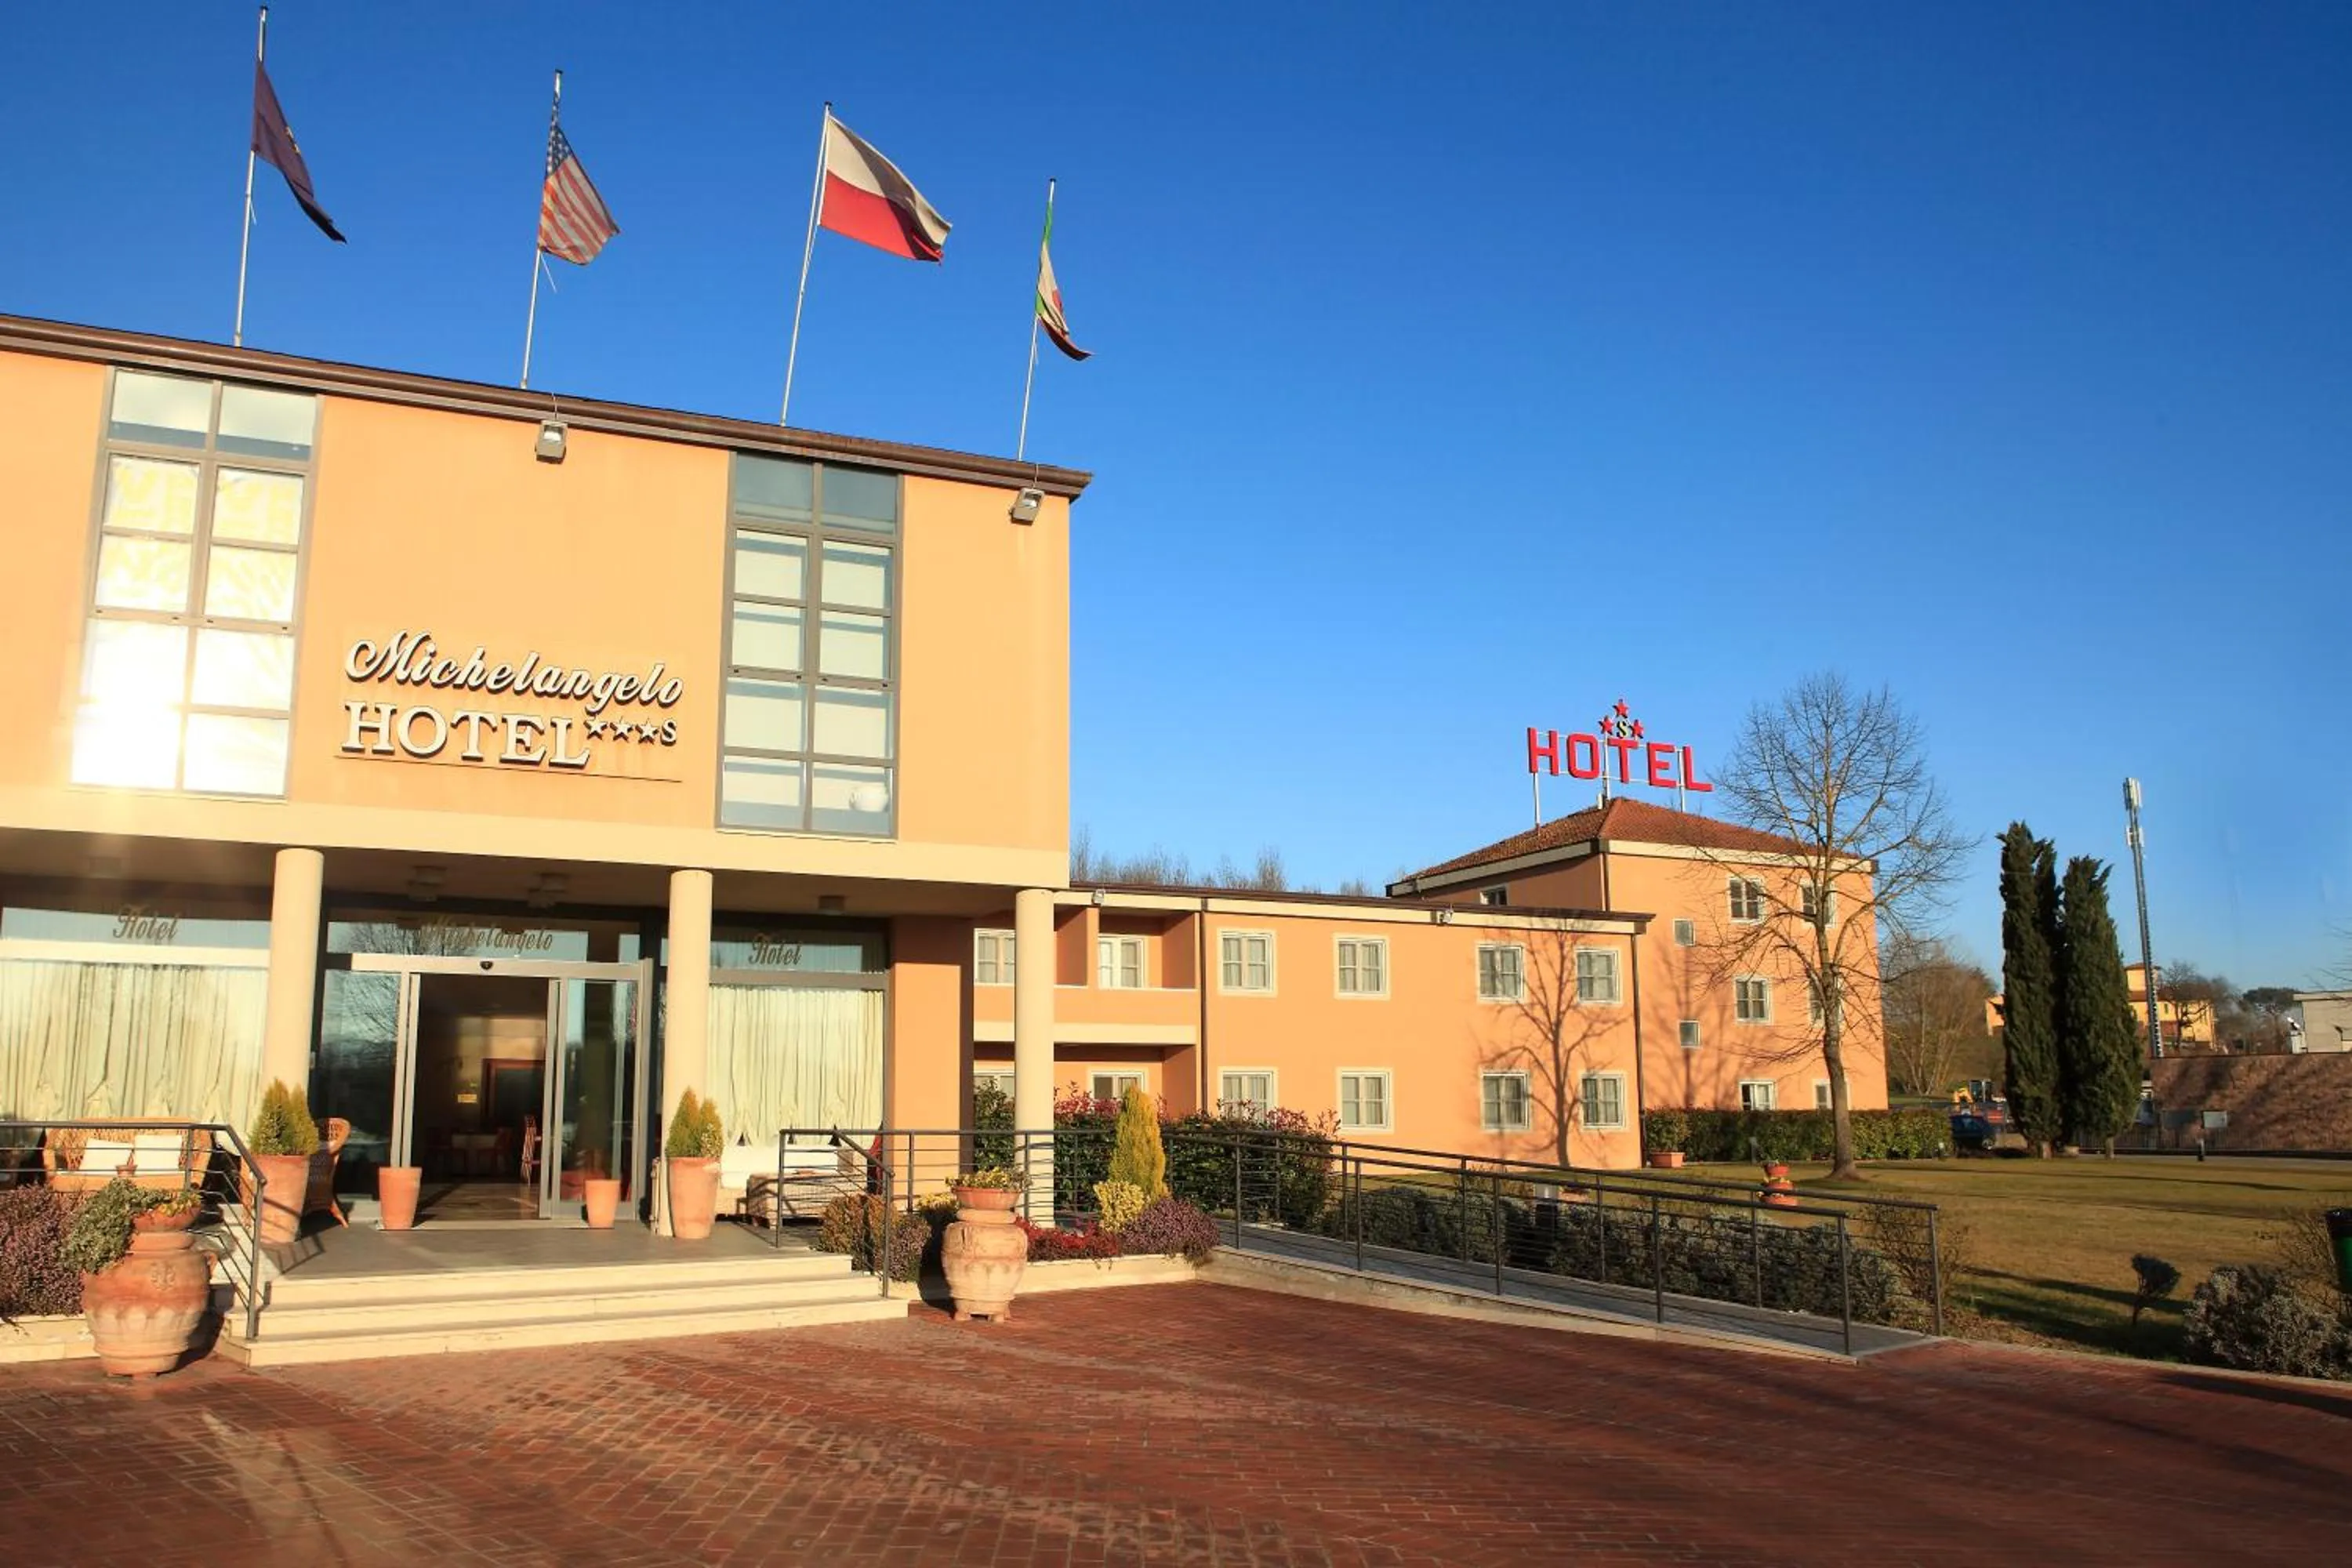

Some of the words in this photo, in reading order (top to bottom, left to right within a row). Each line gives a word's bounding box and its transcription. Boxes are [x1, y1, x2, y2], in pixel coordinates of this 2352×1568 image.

[345, 629, 684, 713] Michelangelo
[341, 699, 590, 768] HOTEL
[1526, 726, 1714, 792] HOTEL
[112, 905, 179, 942] Hotel
[748, 933, 803, 966] Hotel
